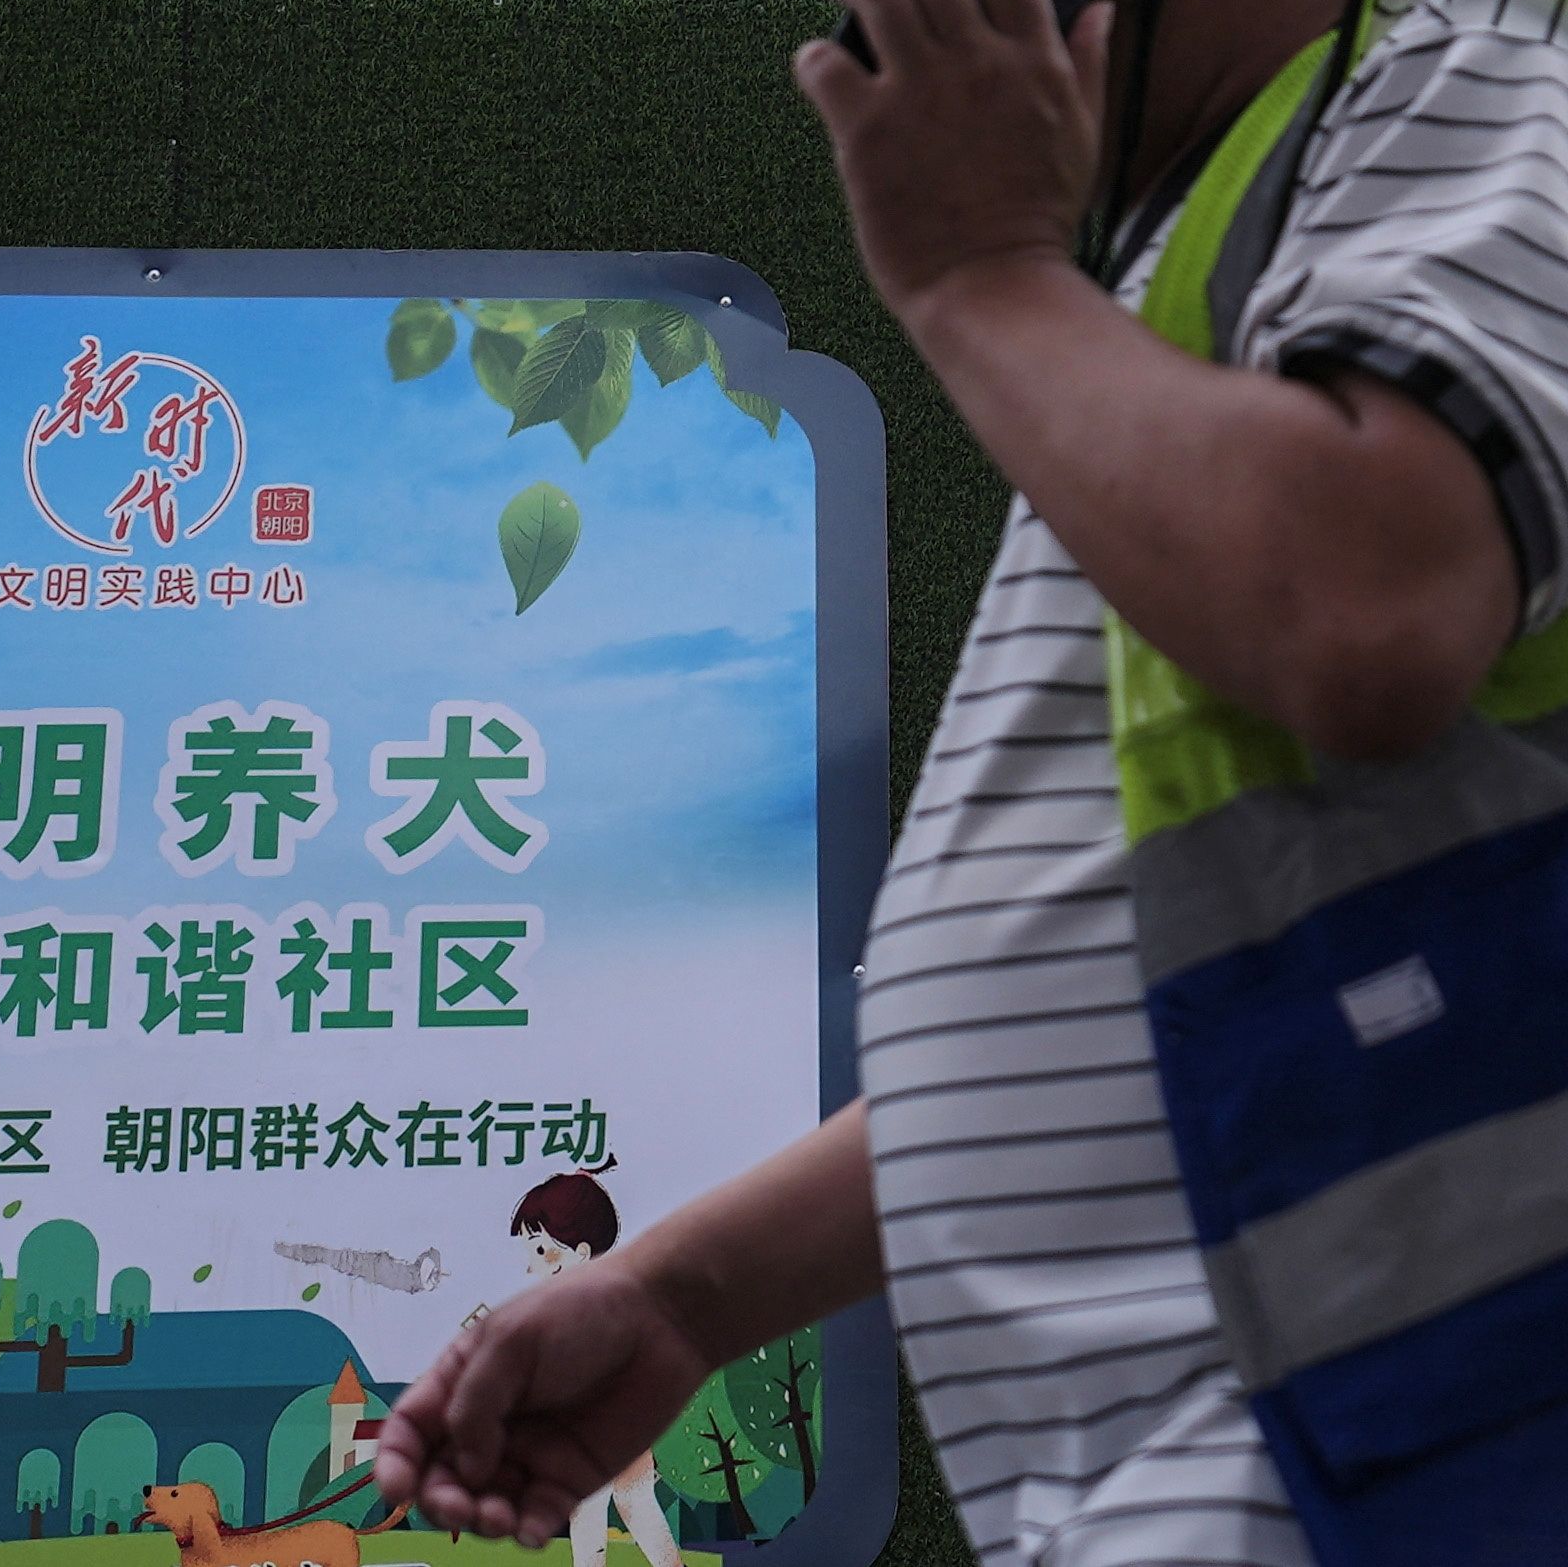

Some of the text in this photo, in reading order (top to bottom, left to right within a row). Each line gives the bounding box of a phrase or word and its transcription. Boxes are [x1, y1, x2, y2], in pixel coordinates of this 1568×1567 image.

[103, 1098, 608, 1174] 朝阳群众在行动
